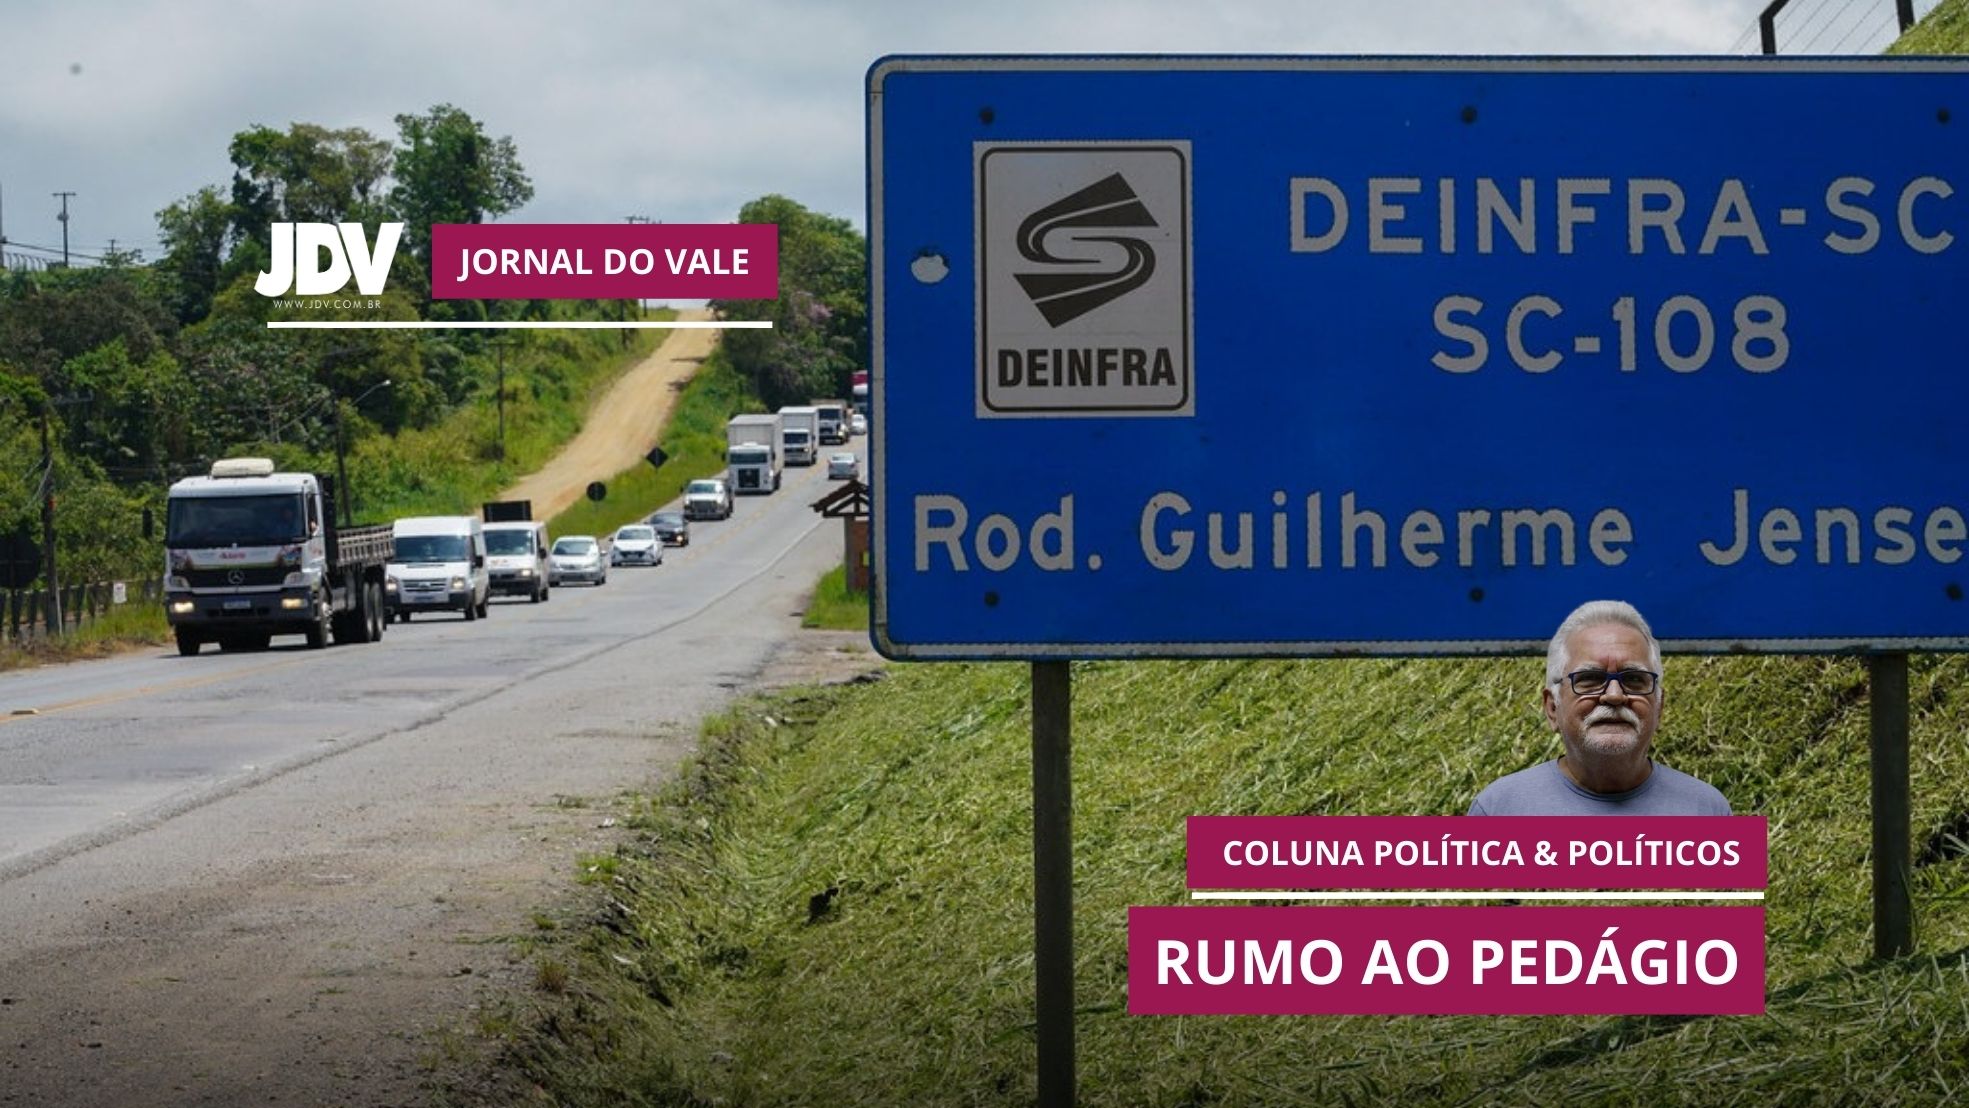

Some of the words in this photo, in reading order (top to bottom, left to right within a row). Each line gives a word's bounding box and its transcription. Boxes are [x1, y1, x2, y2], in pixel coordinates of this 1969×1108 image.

[1290, 176, 1955, 255] DEINFRA-SC
[998, 347, 1176, 389] DEINFRA
[1431, 294, 1790, 374] SC-108
[914, 493, 1102, 572] Rod.
[1140, 490, 1633, 570] Guilherme
[1700, 488, 1968, 566] Jense
